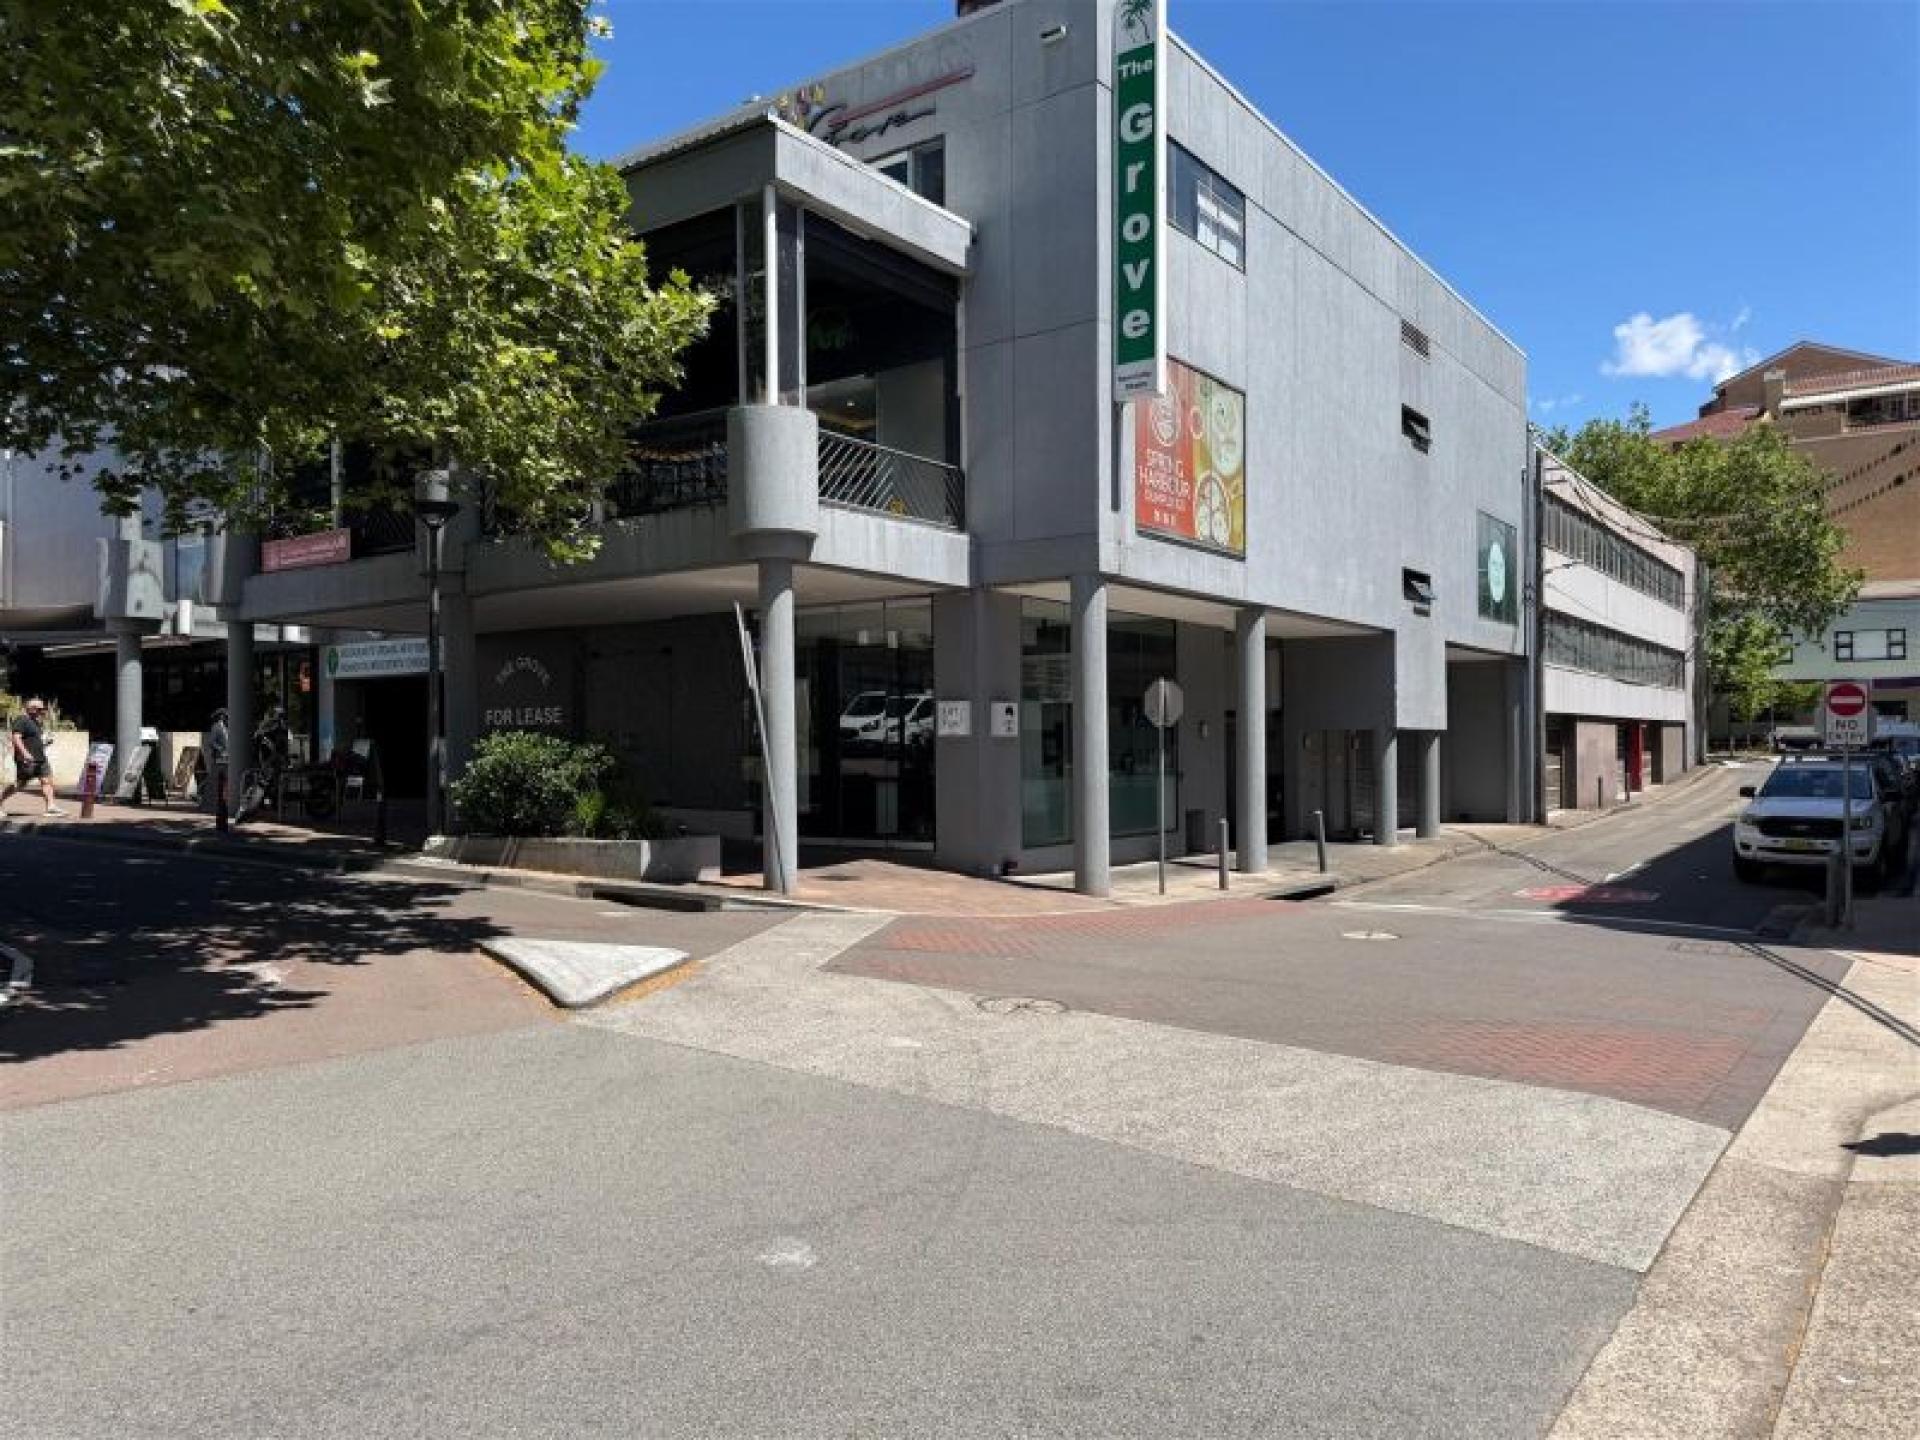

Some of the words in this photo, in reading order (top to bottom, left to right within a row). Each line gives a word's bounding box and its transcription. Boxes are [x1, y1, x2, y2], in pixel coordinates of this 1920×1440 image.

[1117, 57, 1154, 80] The
[1120, 102, 1154, 342] Grove
[485, 709, 513, 726] FOR
[515, 706, 563, 726] LEASE
[1835, 719, 1858, 731] NO
